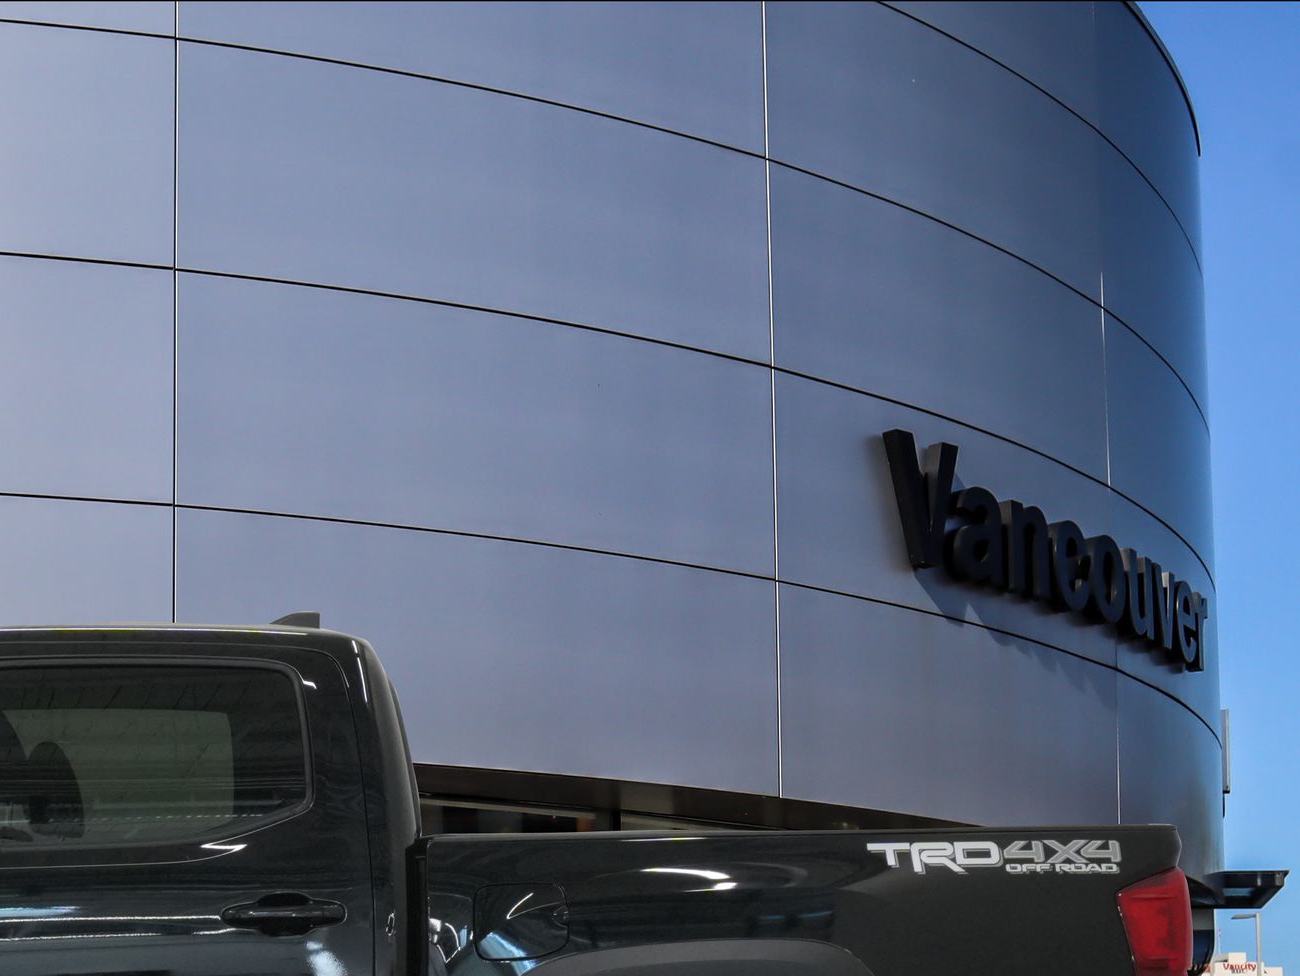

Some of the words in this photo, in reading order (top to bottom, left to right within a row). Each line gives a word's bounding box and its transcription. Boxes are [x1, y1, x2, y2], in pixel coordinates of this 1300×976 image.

[883, 429, 1208, 672] Vancouver
[867, 841, 1003, 875] TRD
[1004, 839, 1122, 864] 4X4
[1005, 862, 1053, 875] OFF
[1055, 862, 1120, 875] ROAD
